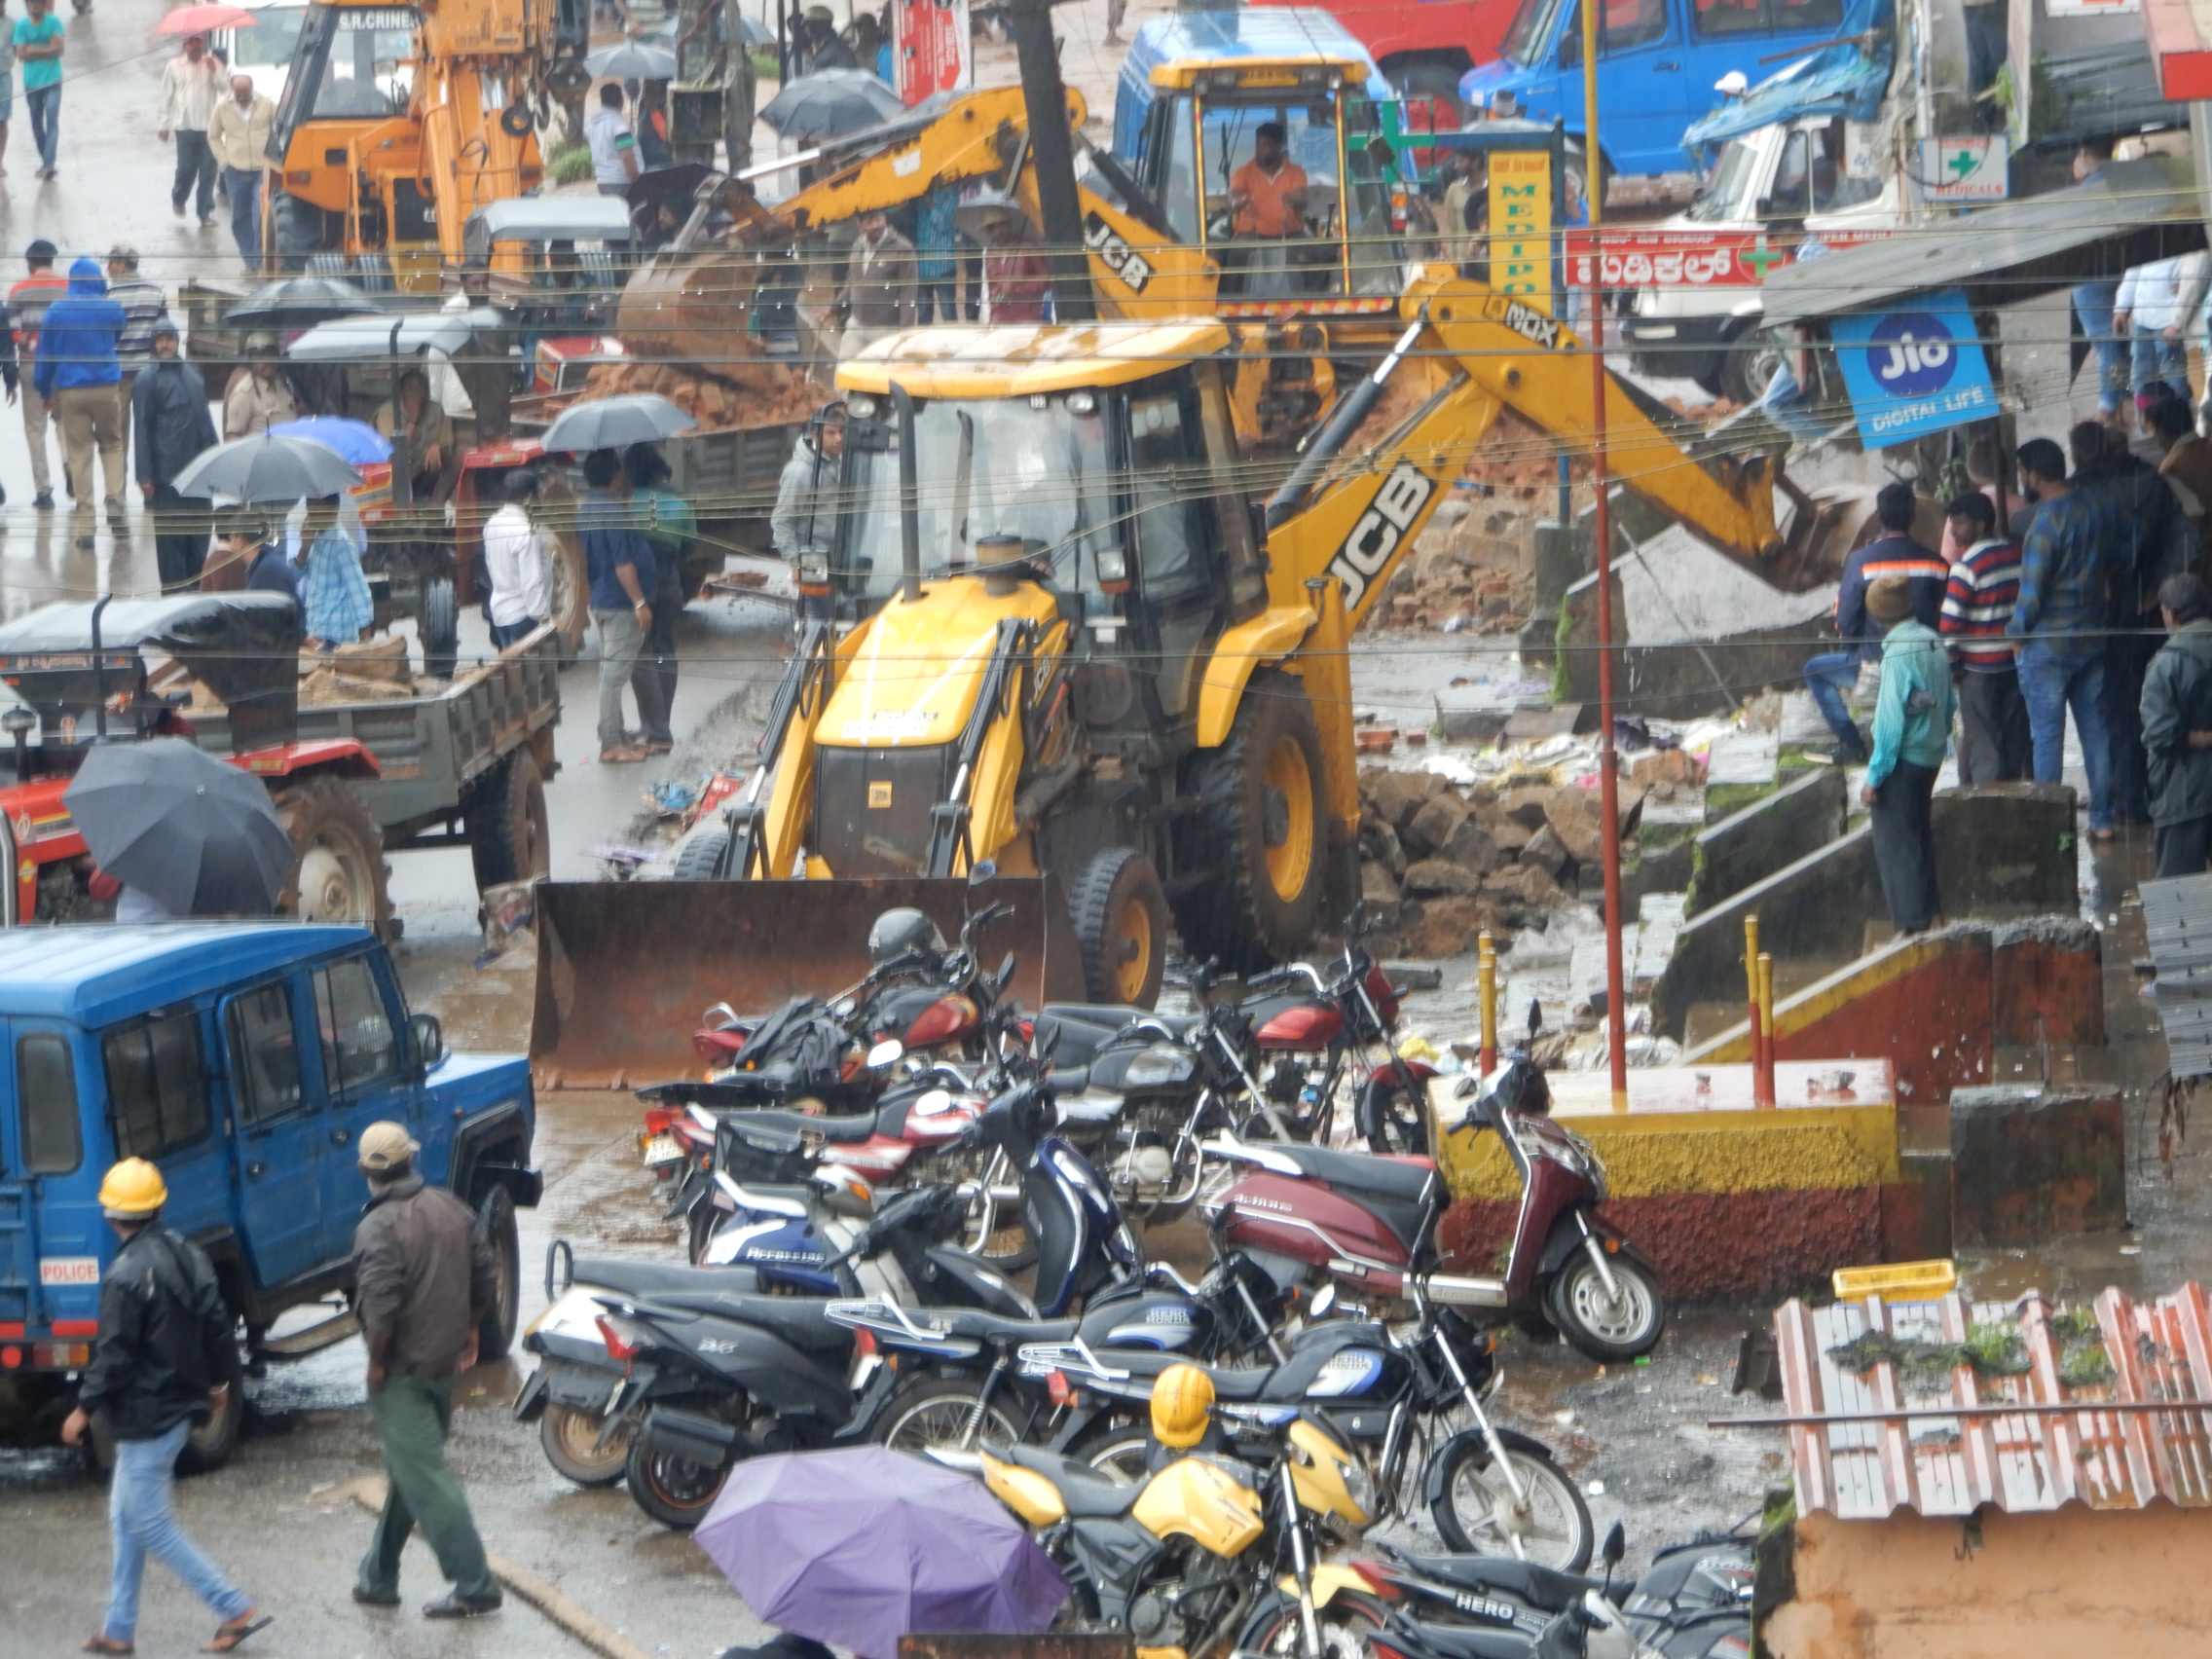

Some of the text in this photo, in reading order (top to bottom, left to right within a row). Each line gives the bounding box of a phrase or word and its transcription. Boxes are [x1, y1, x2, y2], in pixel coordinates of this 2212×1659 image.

[1936, 185, 2003, 196] MEDICALS
[1083, 222, 1149, 289] JCB
[1881, 331, 1949, 380] Jio
[1871, 386, 1985, 432] DIGITAL LIFE
[1330, 462, 1430, 613] JCB
[43, 1264, 96, 1281] POLICE
[1145, 1315, 1192, 1324] HONDA
[1150, 1307, 1187, 1317] HERO
[1456, 1592, 1514, 1620] HERO
